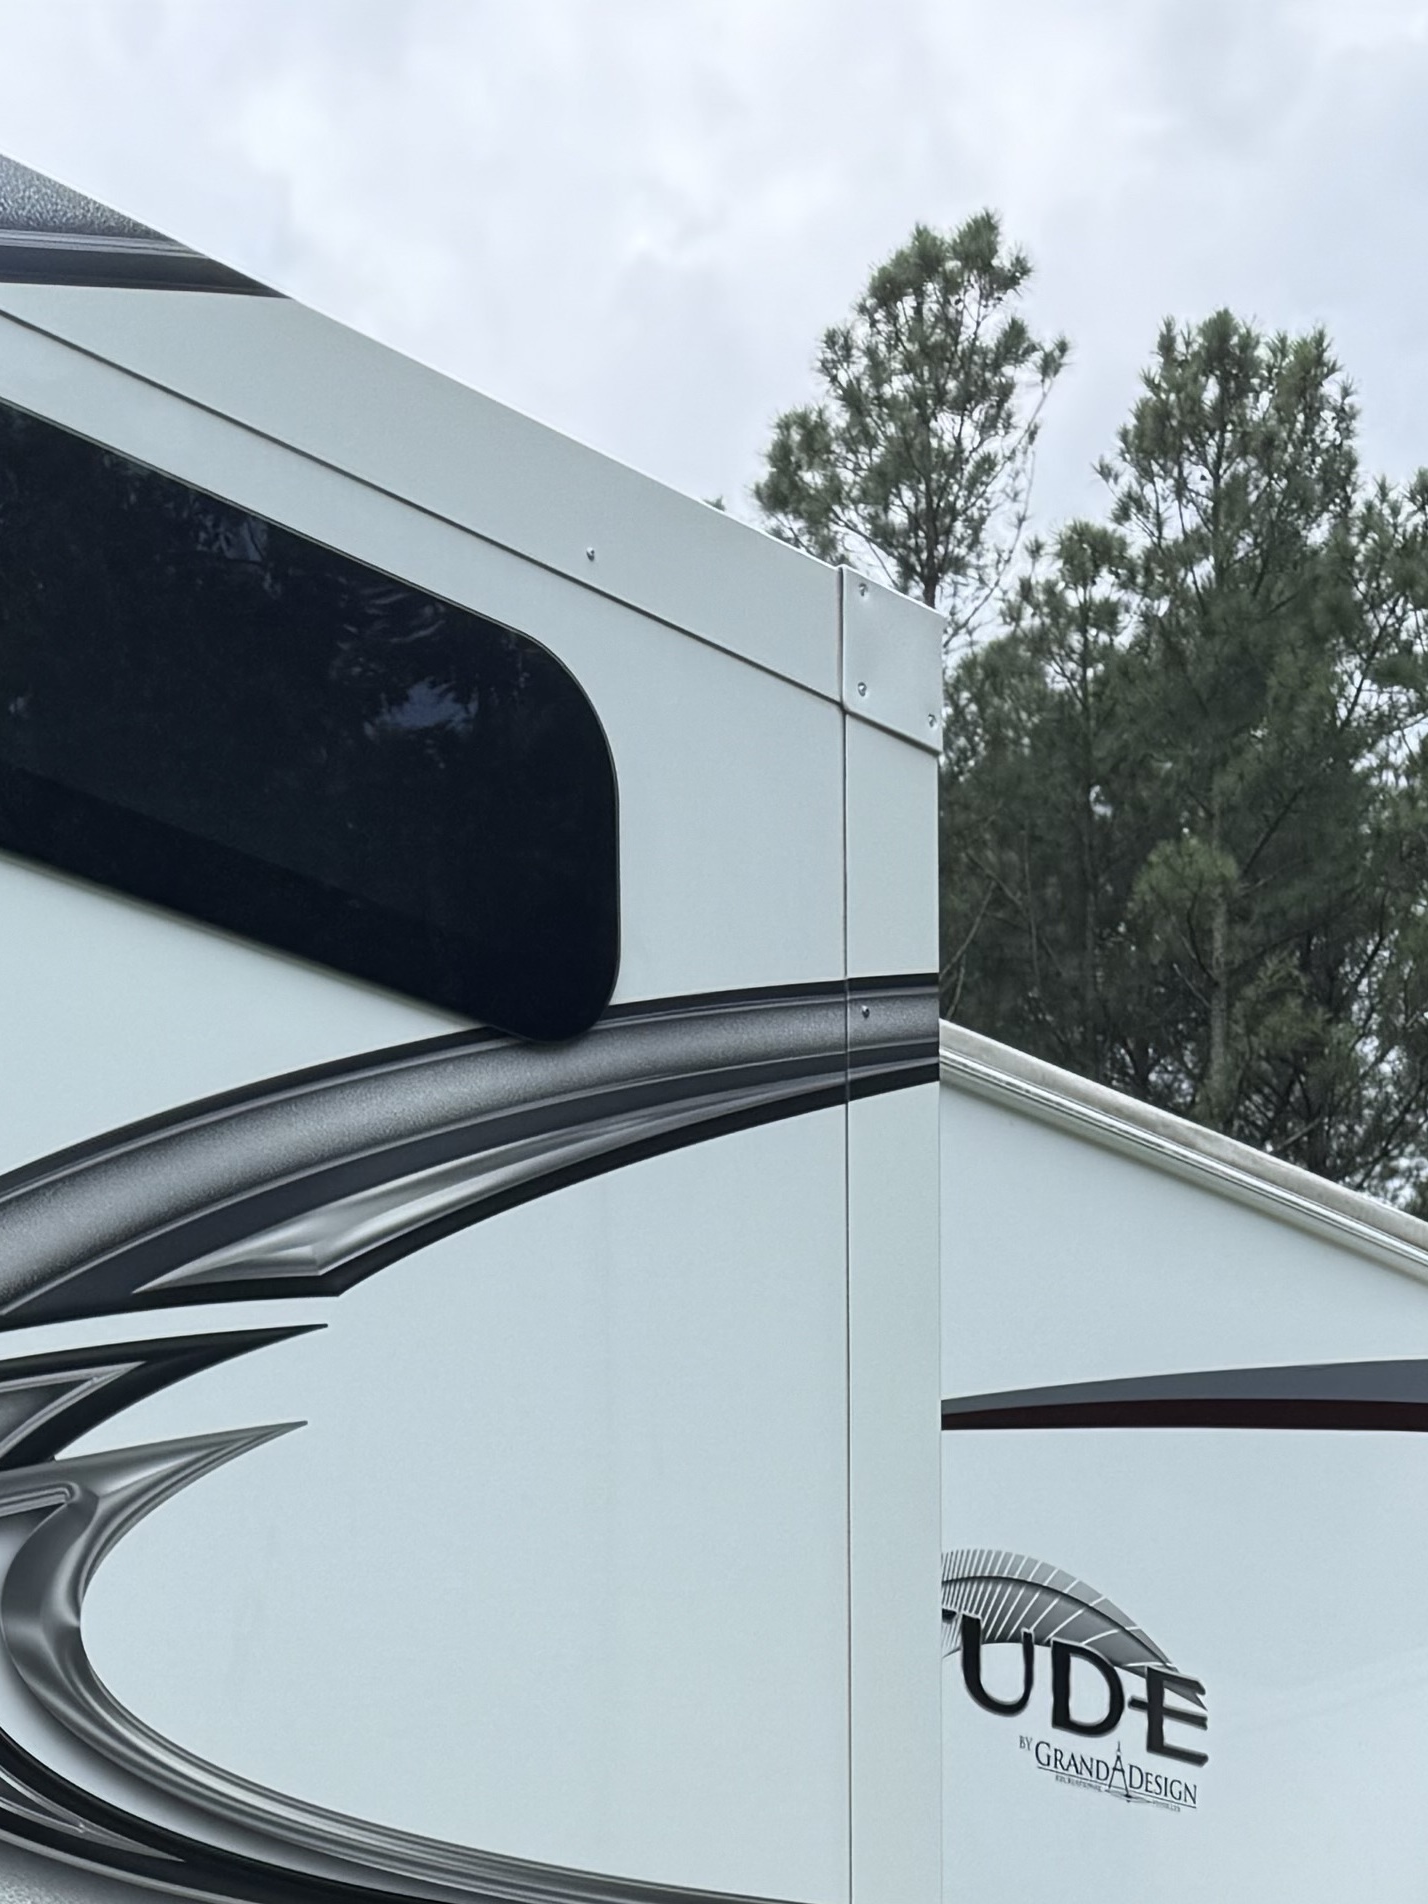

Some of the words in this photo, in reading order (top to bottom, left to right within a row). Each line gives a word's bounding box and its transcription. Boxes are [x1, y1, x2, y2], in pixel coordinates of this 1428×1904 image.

[942, 1607, 1209, 1768] UDE
[1018, 1735, 1033, 1751] BY
[1035, 1741, 1110, 1782] GRAND
[1128, 1763, 1198, 1804] DESIGN
